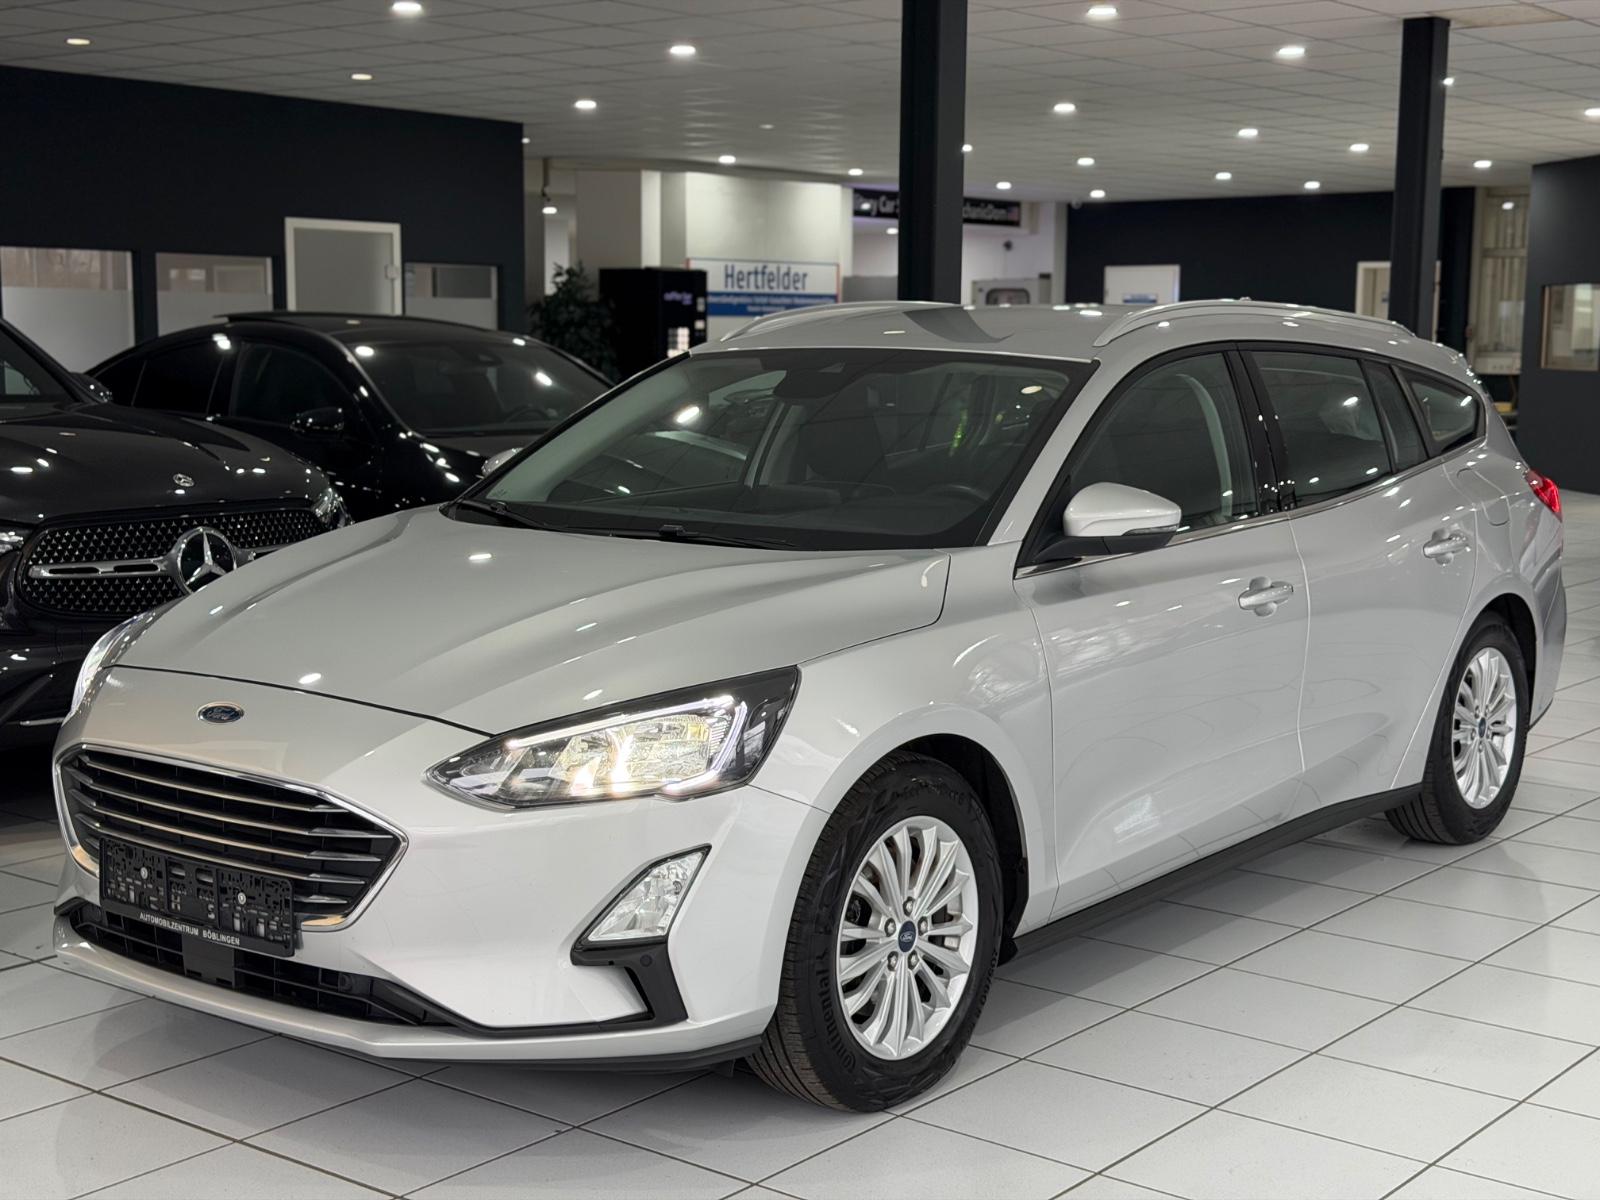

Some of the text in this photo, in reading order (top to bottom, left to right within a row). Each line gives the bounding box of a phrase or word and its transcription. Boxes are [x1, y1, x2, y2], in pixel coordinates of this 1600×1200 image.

[724, 264, 808, 291] Hertfelder
[140, 912, 240, 945] AUTOMOBILZENTRUM BÖBLINGEN
[816, 969, 856, 1073] Continental
